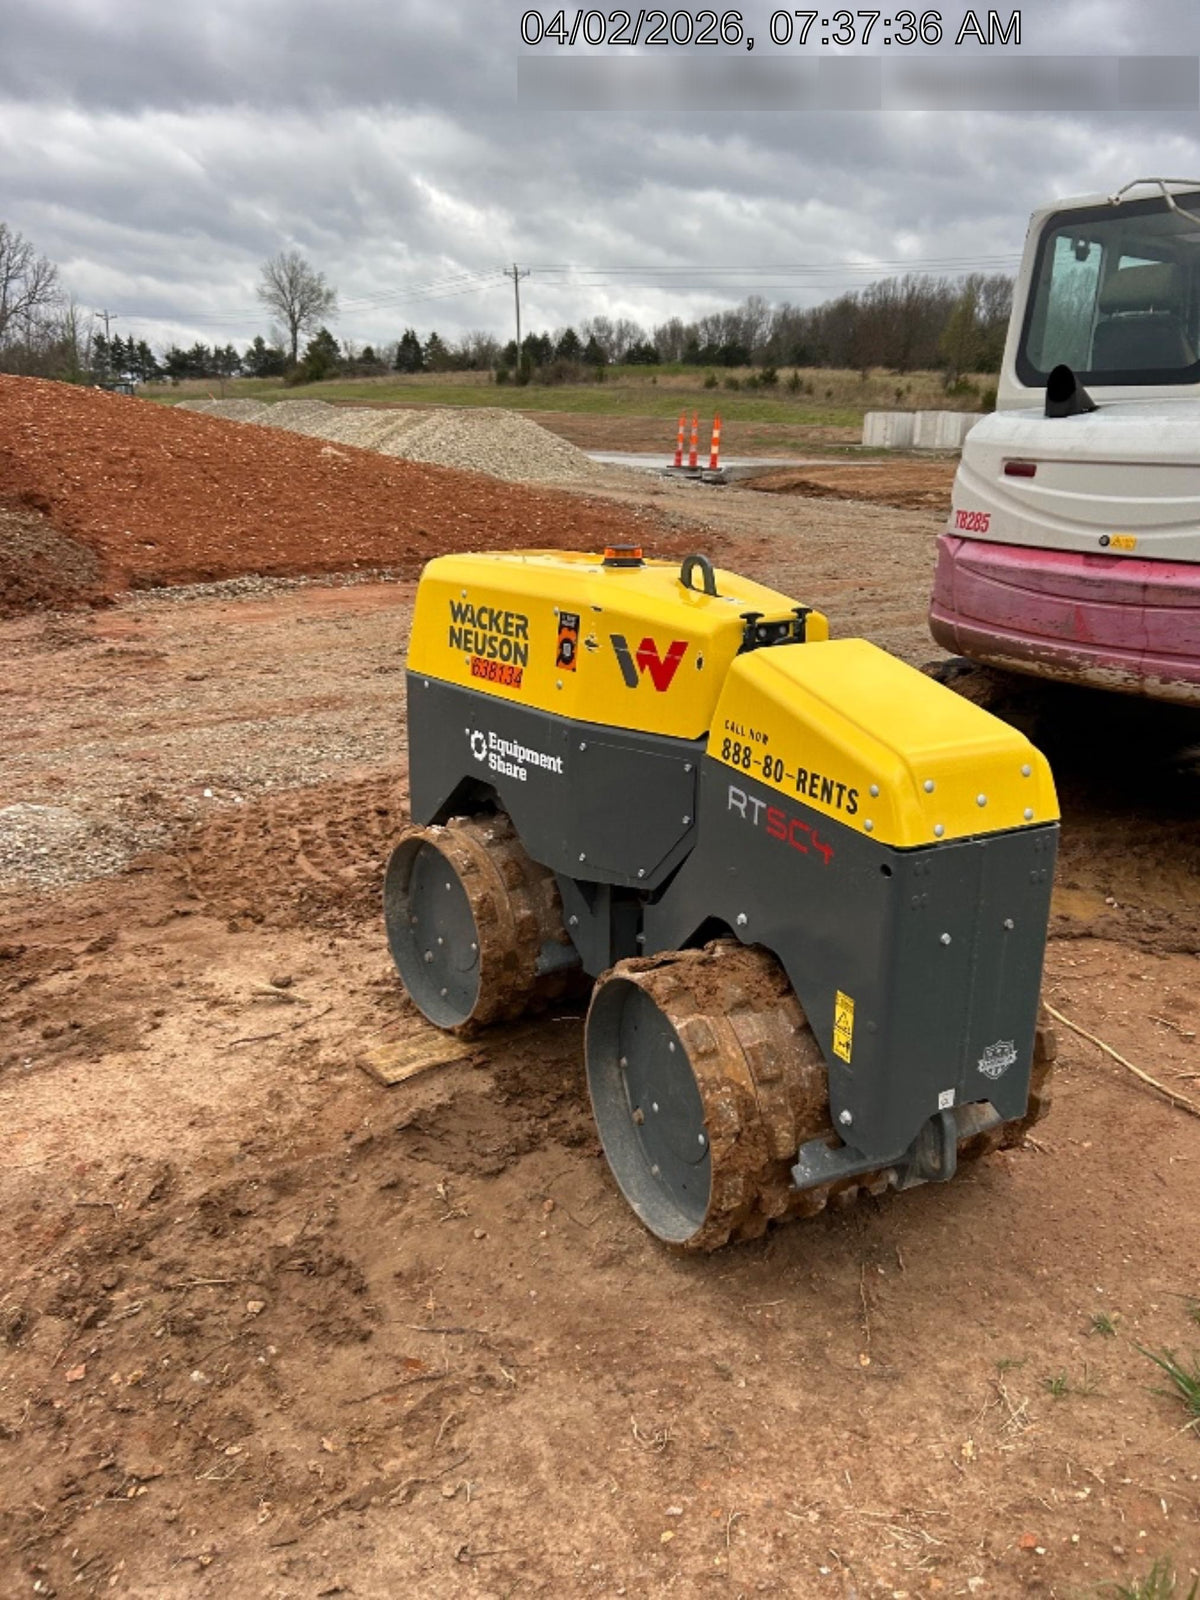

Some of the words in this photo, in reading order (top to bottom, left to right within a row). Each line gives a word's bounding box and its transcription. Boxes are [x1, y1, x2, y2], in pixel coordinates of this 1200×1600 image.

[954, 510, 992, 533] TB285
[449, 599, 529, 641] WACKER
[449, 625, 529, 667] NEUSON
[471, 657, 523, 686] 638134
[724, 719, 746, 737] CALL
[749, 728, 769, 746] NOW
[488, 731, 563, 775] Equipment
[488, 752, 527, 782] Share
[721, 737, 860, 815] 888-80-RENTS
